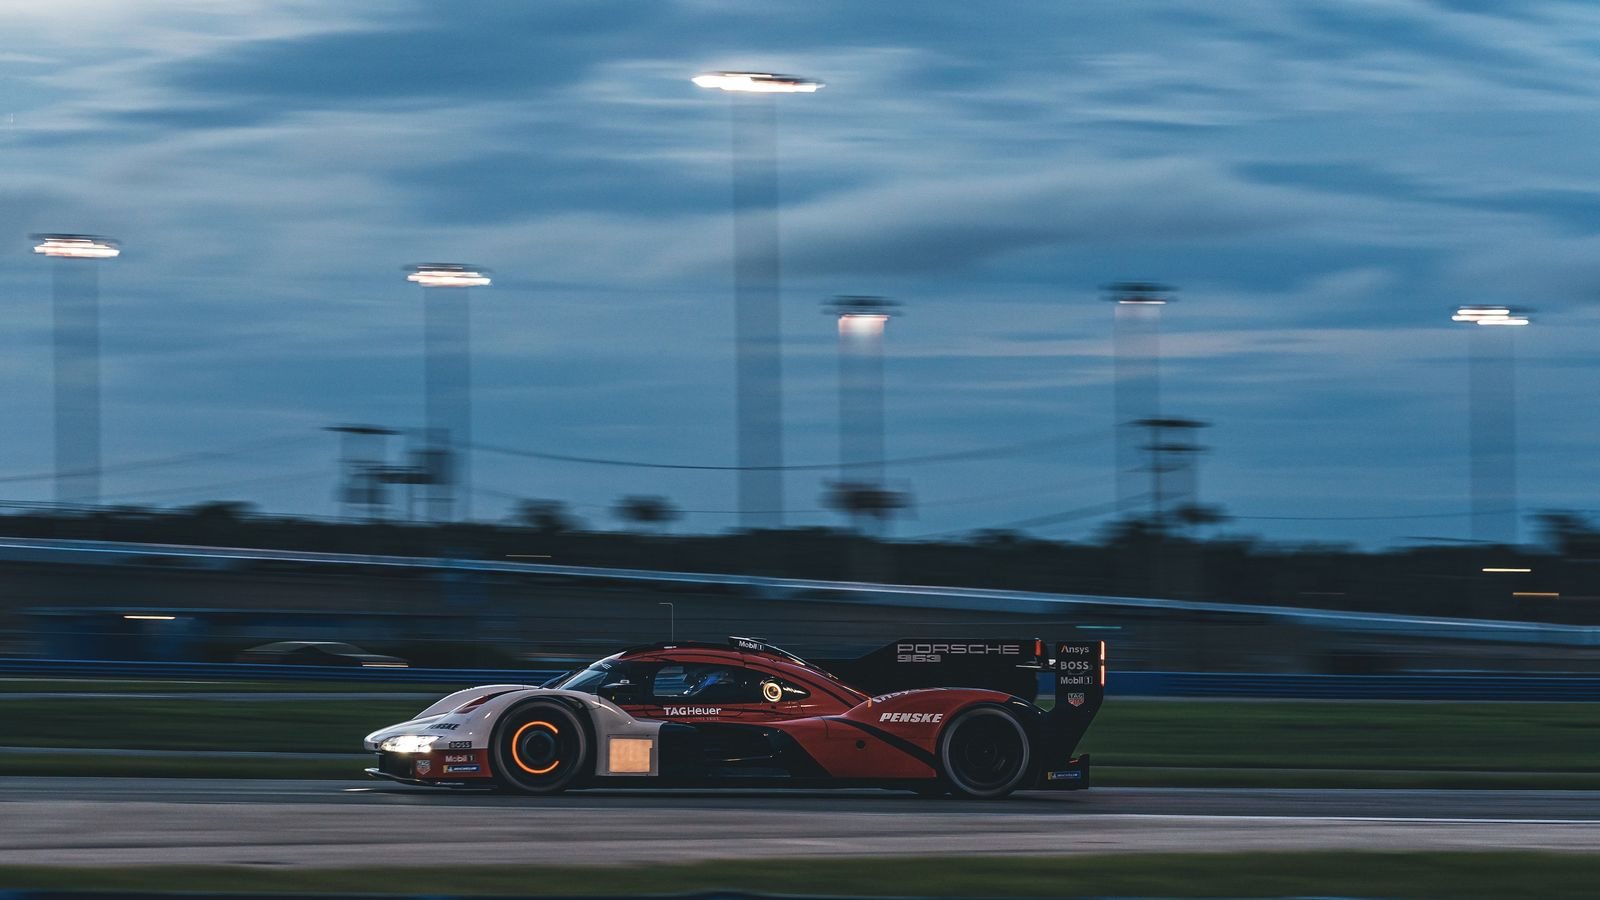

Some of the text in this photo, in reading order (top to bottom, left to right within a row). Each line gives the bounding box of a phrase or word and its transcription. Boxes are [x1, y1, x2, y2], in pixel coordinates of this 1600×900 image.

[738, 640, 757, 650] Mobil
[897, 644, 1020, 655] PORSCHE
[1061, 645, 1090, 655] Ansys
[897, 654, 941, 663] 963
[1060, 661, 1089, 670] BOSS
[1060, 676, 1083, 685] Mobil
[880, 712, 943, 723] PENSKE
[445, 755, 468, 763] Mobil
